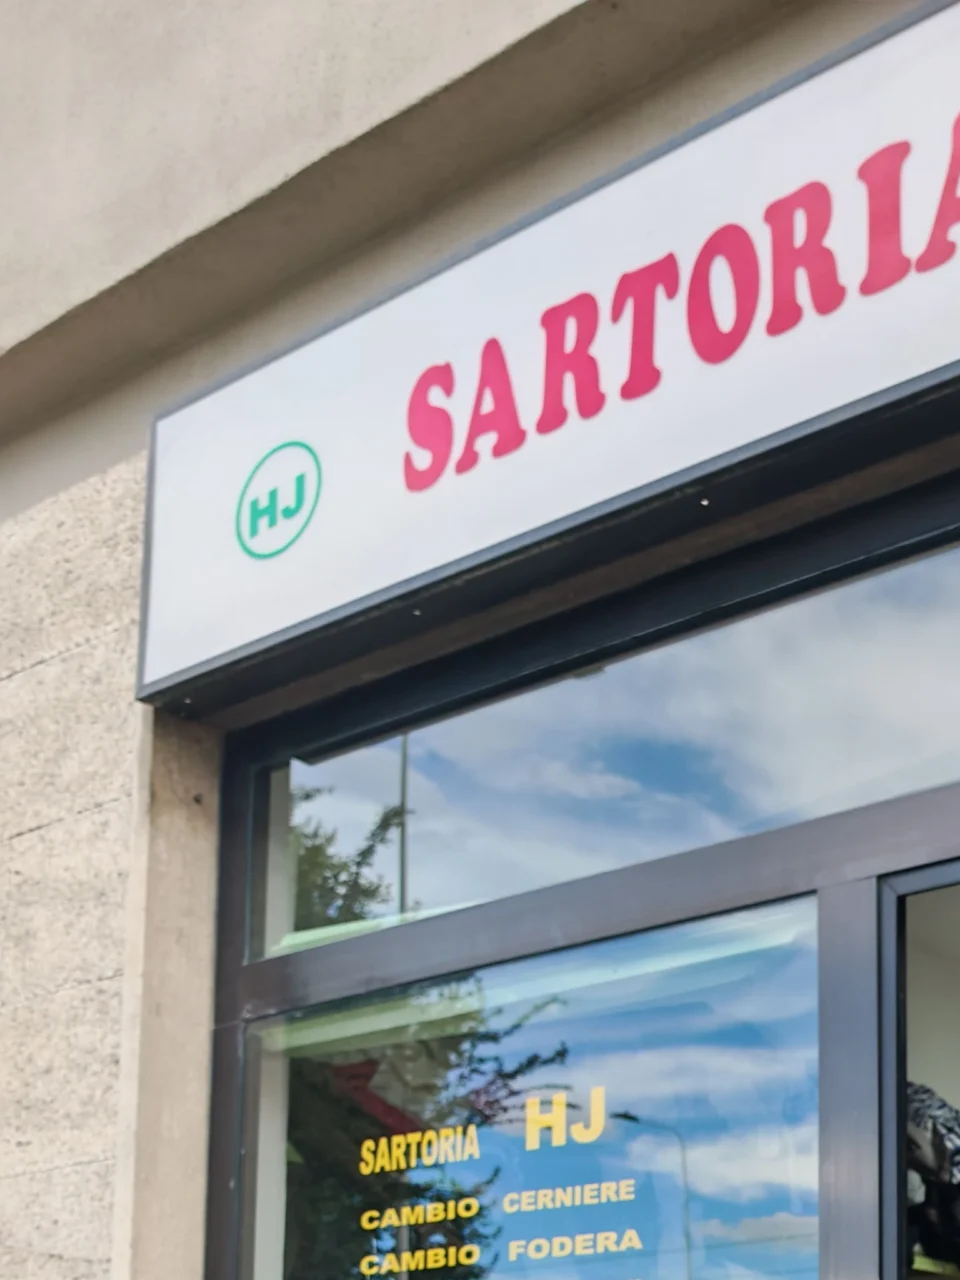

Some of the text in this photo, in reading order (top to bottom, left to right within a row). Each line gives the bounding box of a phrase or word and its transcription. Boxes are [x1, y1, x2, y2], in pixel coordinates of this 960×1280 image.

[249, 471, 305, 539] HJ
[358, 1086, 606, 1176] SARTORIA HJ
[360, 1179, 636, 1230] CAMBIO CERNIERE
[359, 1228, 643, 1276] CAMBIO FODERA
